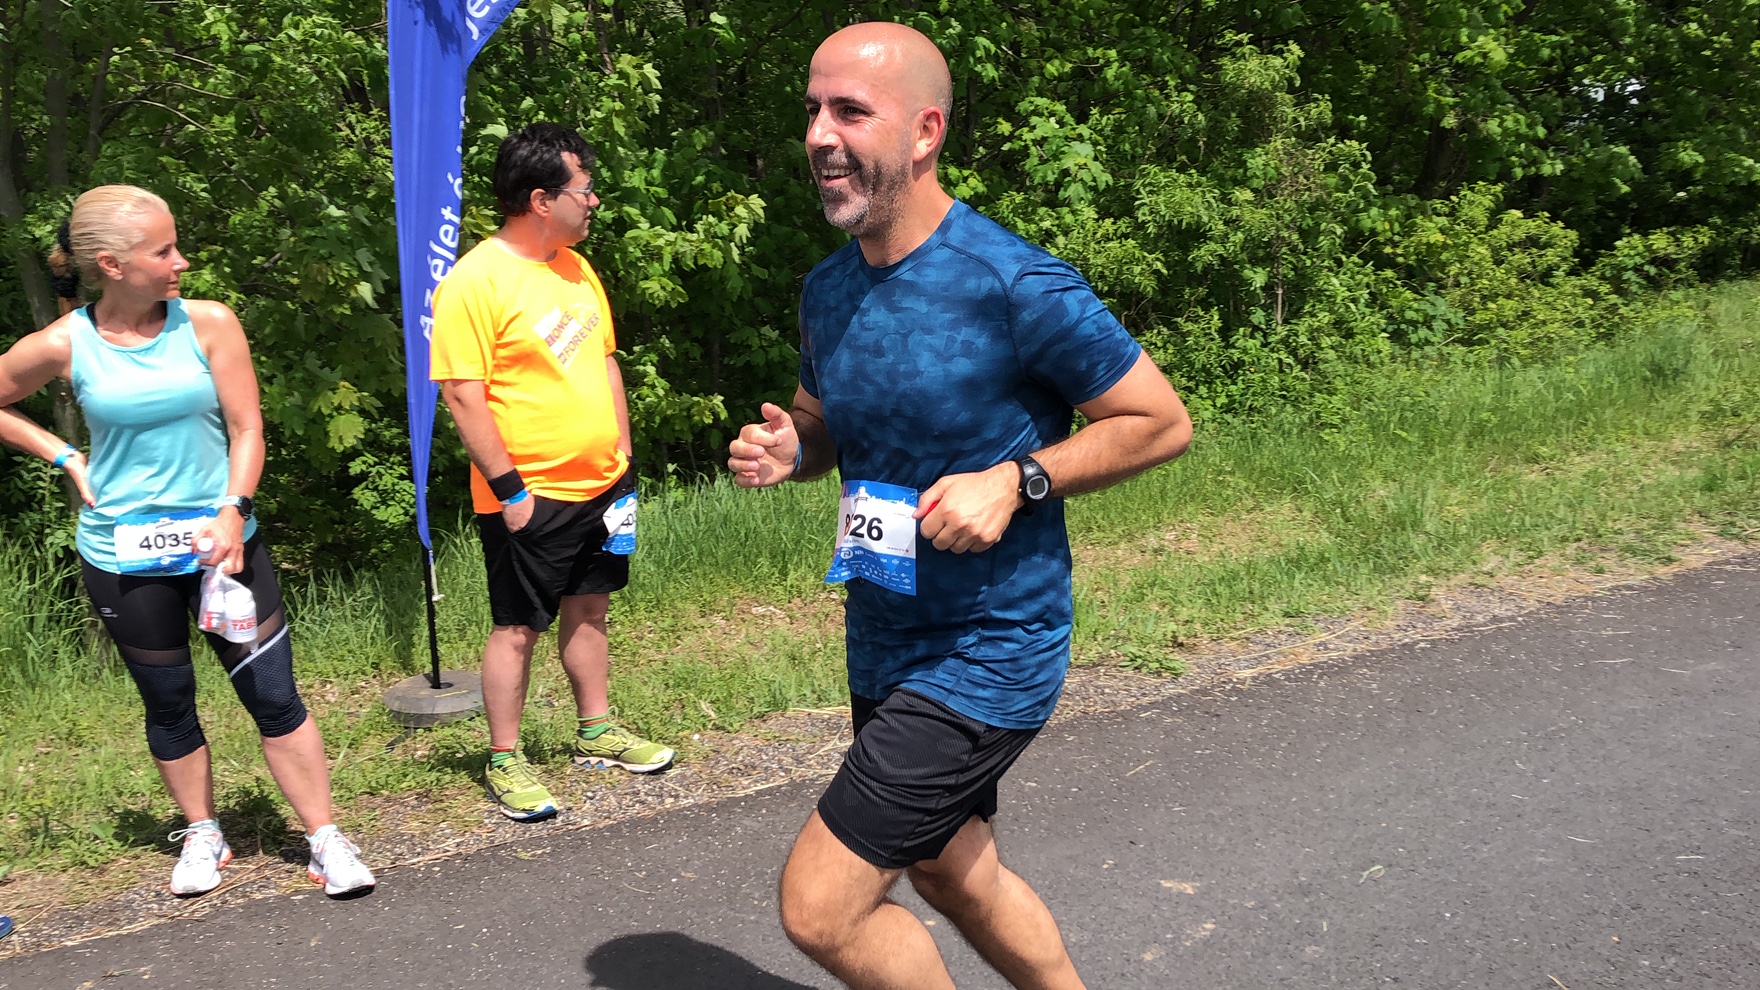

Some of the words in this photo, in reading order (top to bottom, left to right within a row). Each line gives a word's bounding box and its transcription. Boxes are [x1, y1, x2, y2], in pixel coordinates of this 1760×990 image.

[427, 205, 460, 282] élet
[563, 312, 600, 358] FOREVER
[139, 531, 192, 550] 4035
